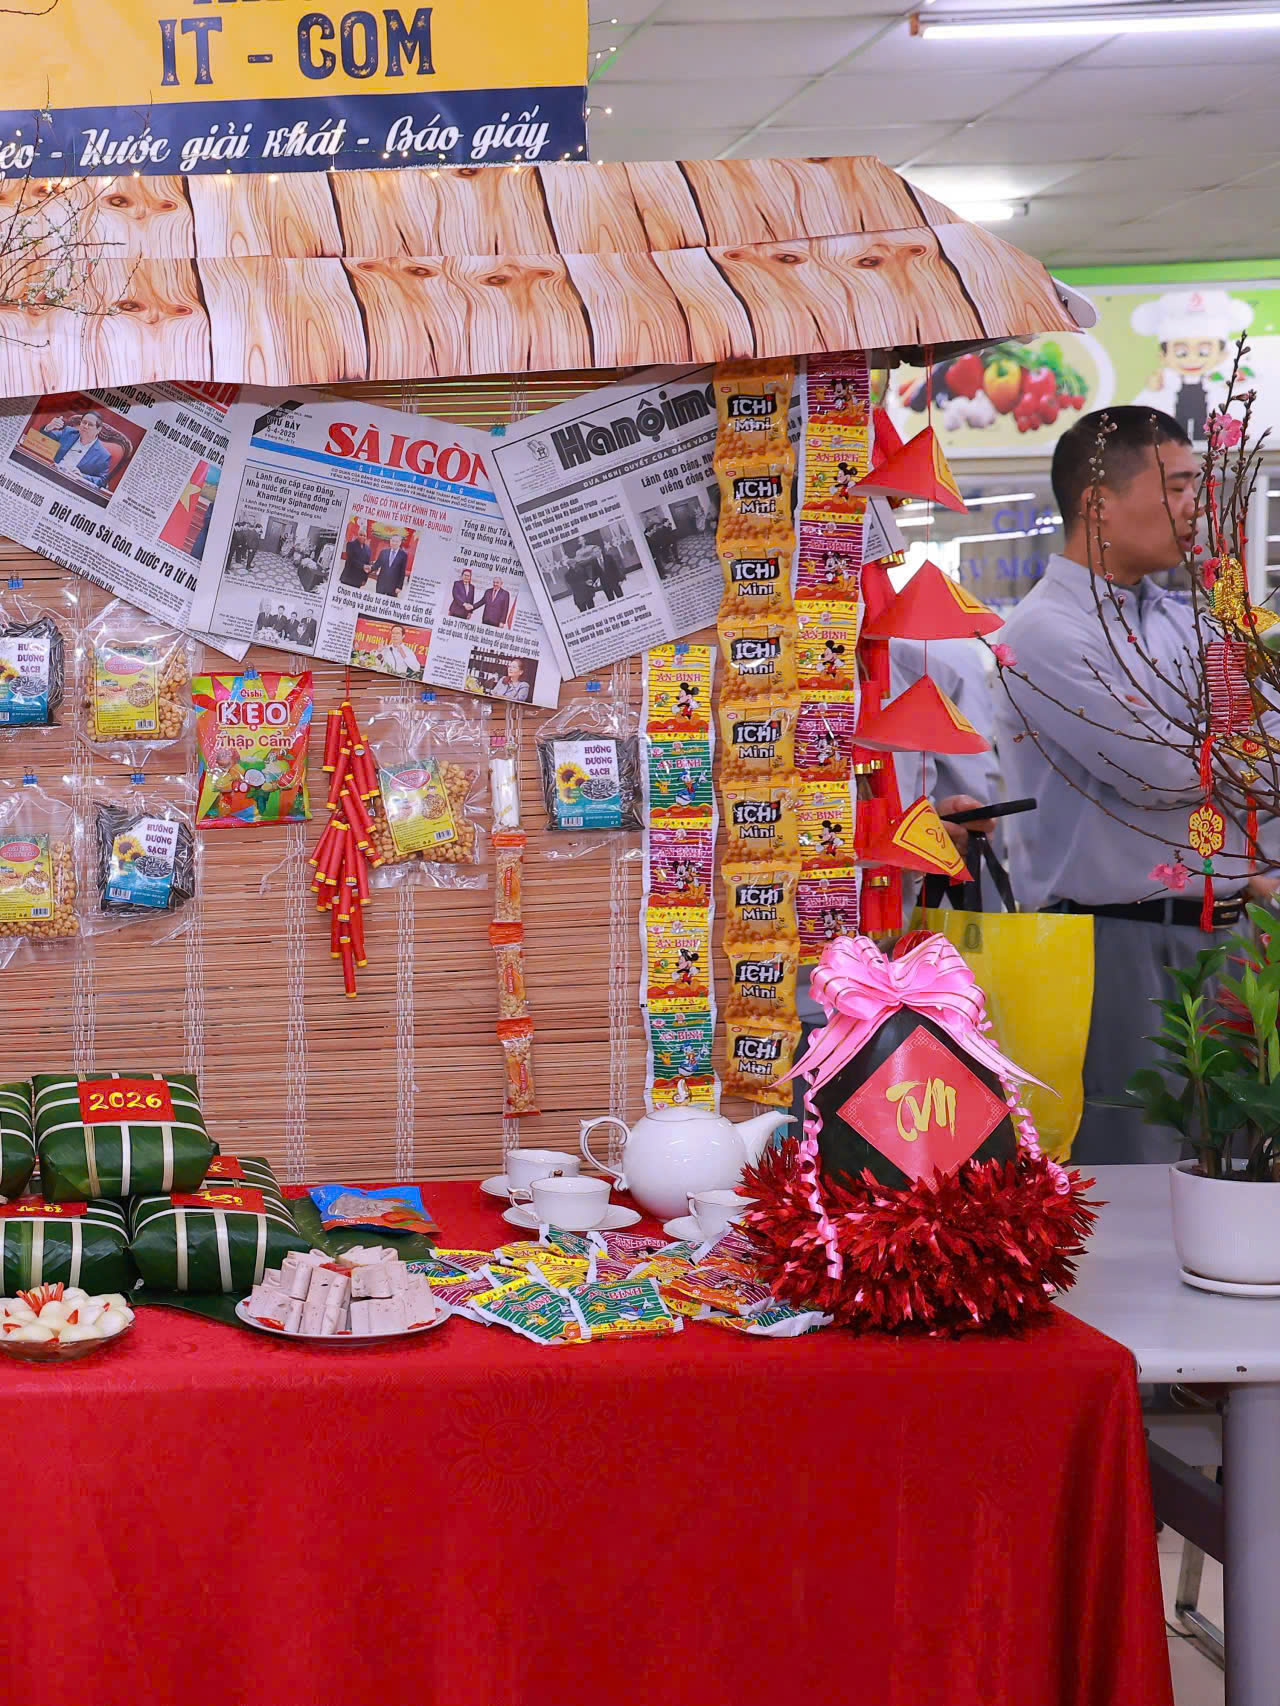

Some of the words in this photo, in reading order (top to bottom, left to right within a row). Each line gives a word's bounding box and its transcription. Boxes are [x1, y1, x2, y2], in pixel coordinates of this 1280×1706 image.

[159, 17, 222, 86] IT
[297, 8, 436, 80] COM
[179, 120, 253, 171] giải
[386, 114, 462, 154] Báo
[471, 105, 551, 159] giấy
[49, 501, 71, 523] Biệt
[70, 512, 98, 536] động
[134, 546, 160, 570] bước
[159, 560, 174, 577] ra
[219, 734, 254, 750] Thập
[258, 731, 291, 747] Cẩm
[221, 701, 288, 732] KẸO
[89, 1091, 163, 1111] 2026
